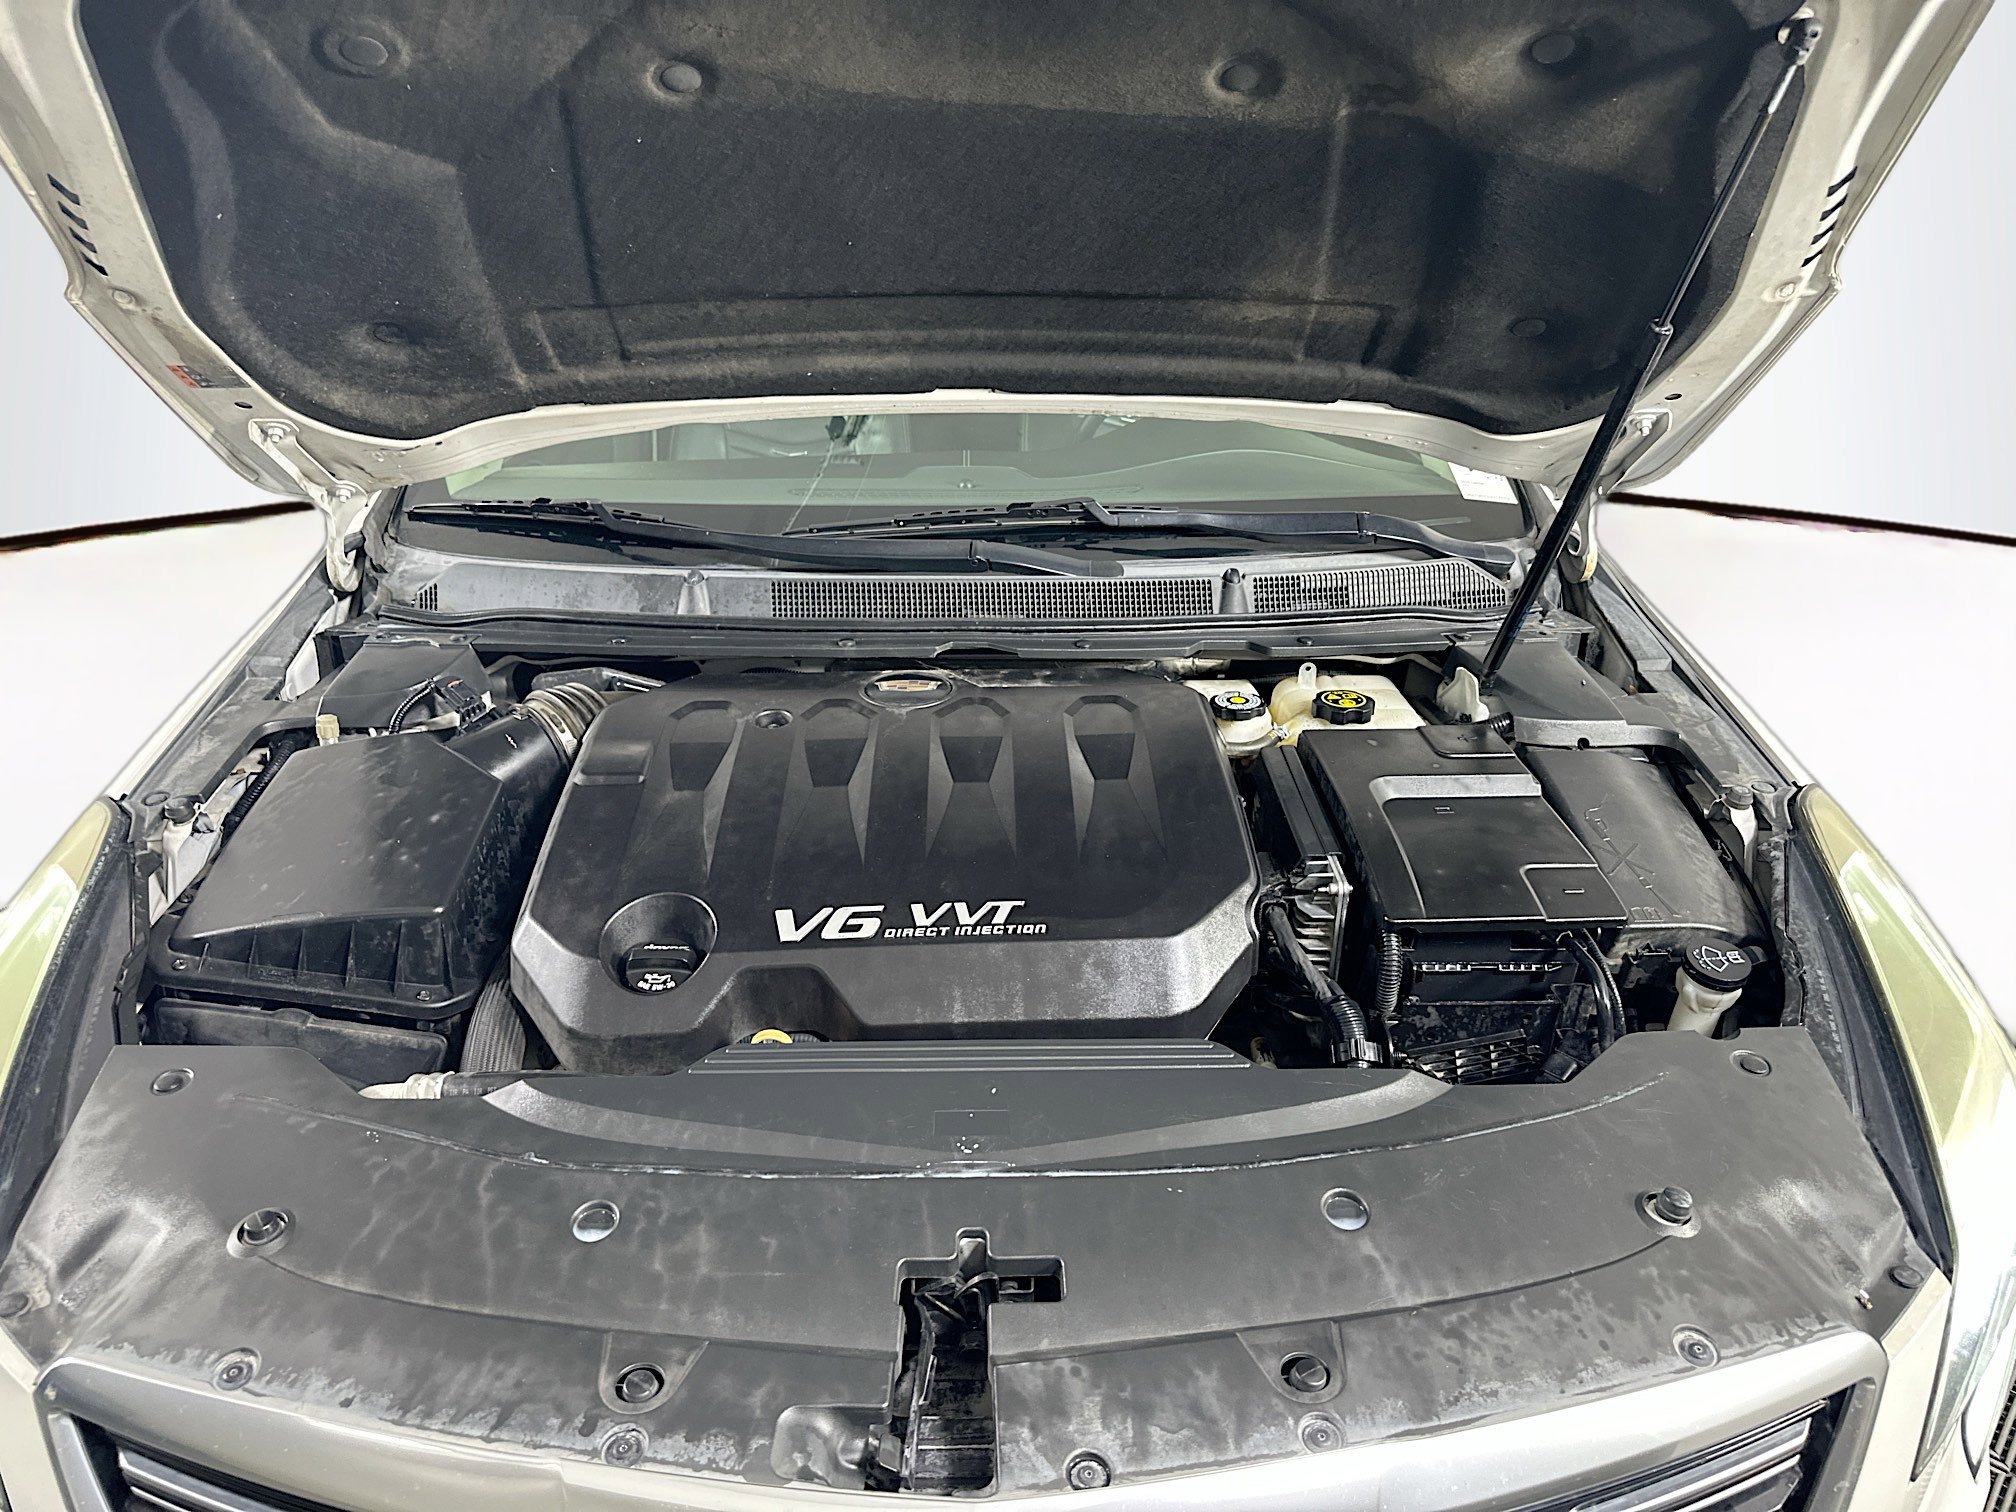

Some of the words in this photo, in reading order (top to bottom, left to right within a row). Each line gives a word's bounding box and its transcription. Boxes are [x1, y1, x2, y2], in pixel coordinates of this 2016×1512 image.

[774, 904, 885, 943] V6
[910, 900, 1026, 927] VVT
[883, 926, 951, 939] DIRECT
[954, 923, 1047, 936] INJECTION
